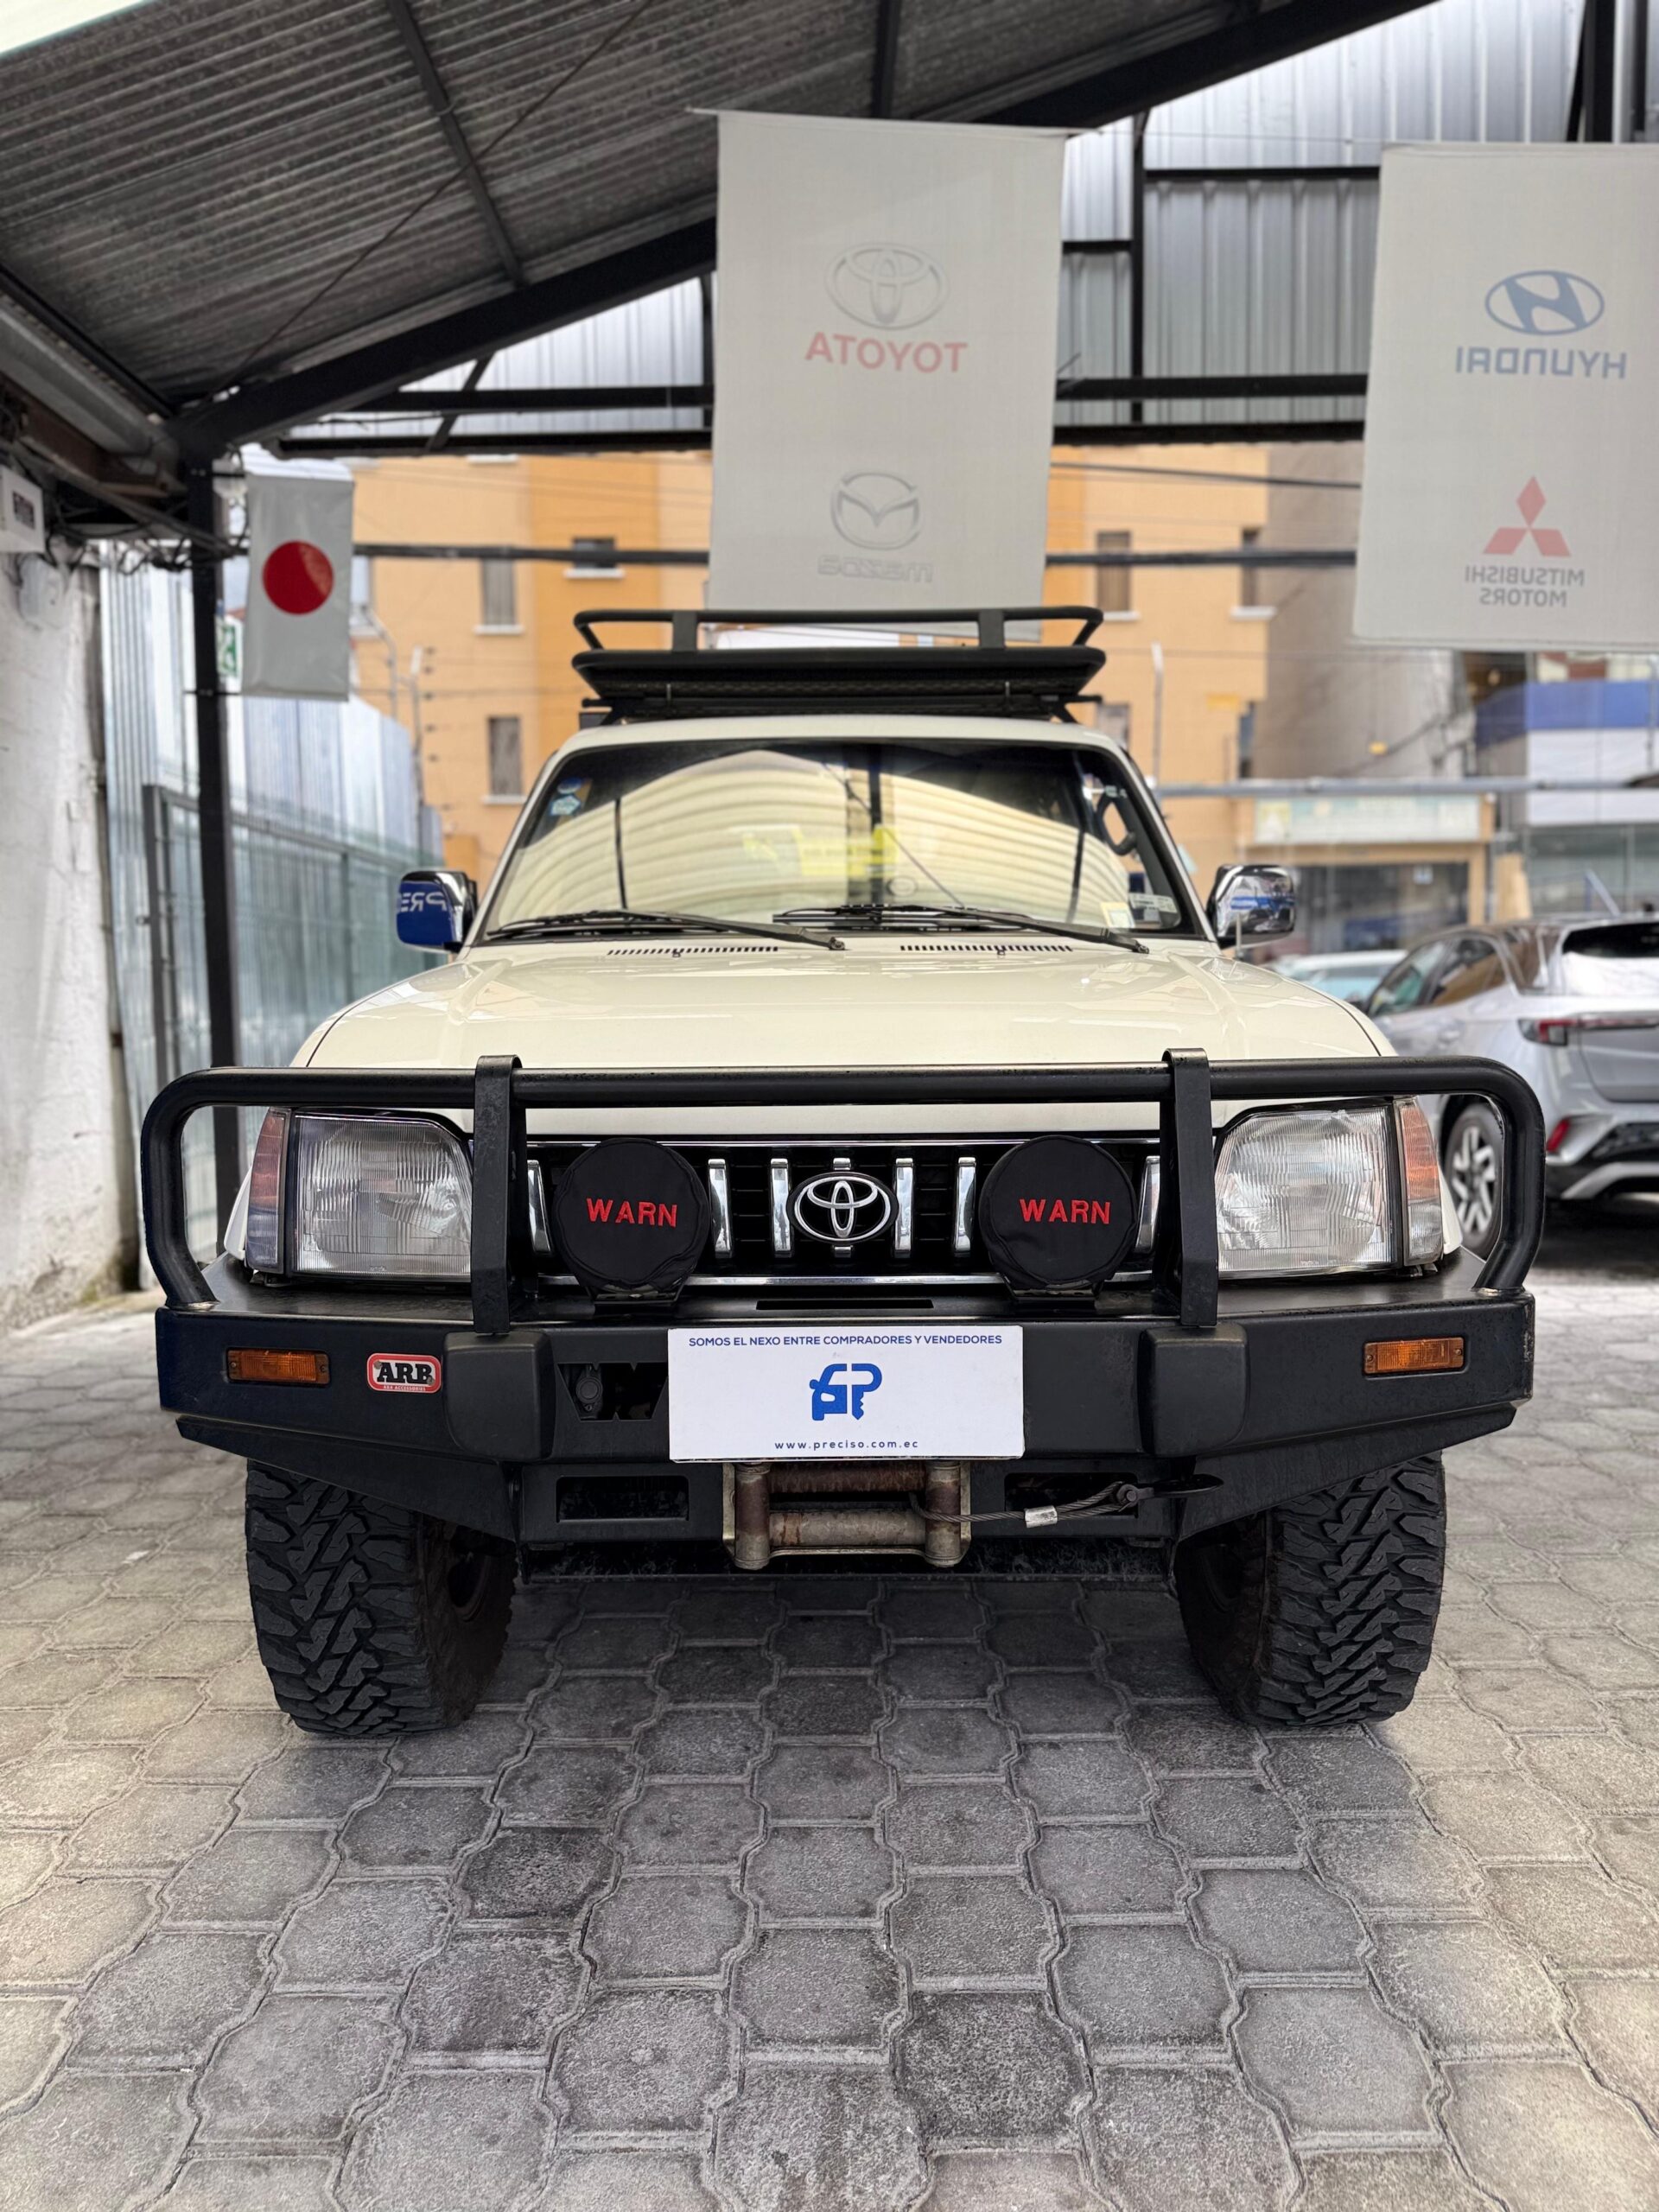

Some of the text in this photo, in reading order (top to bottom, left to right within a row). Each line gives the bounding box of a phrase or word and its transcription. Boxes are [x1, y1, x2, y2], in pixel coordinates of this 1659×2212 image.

[586, 1198, 677, 1227] WARN
[1020, 1198, 1110, 1224] WARN
[689, 1335, 1002, 1347] SOMOS EL NEXO ENTRE COMPRADORES Y VENDEDORES
[377, 1362, 431, 1384] ARB
[774, 1440, 918, 1451] www.preciso.com.ec
